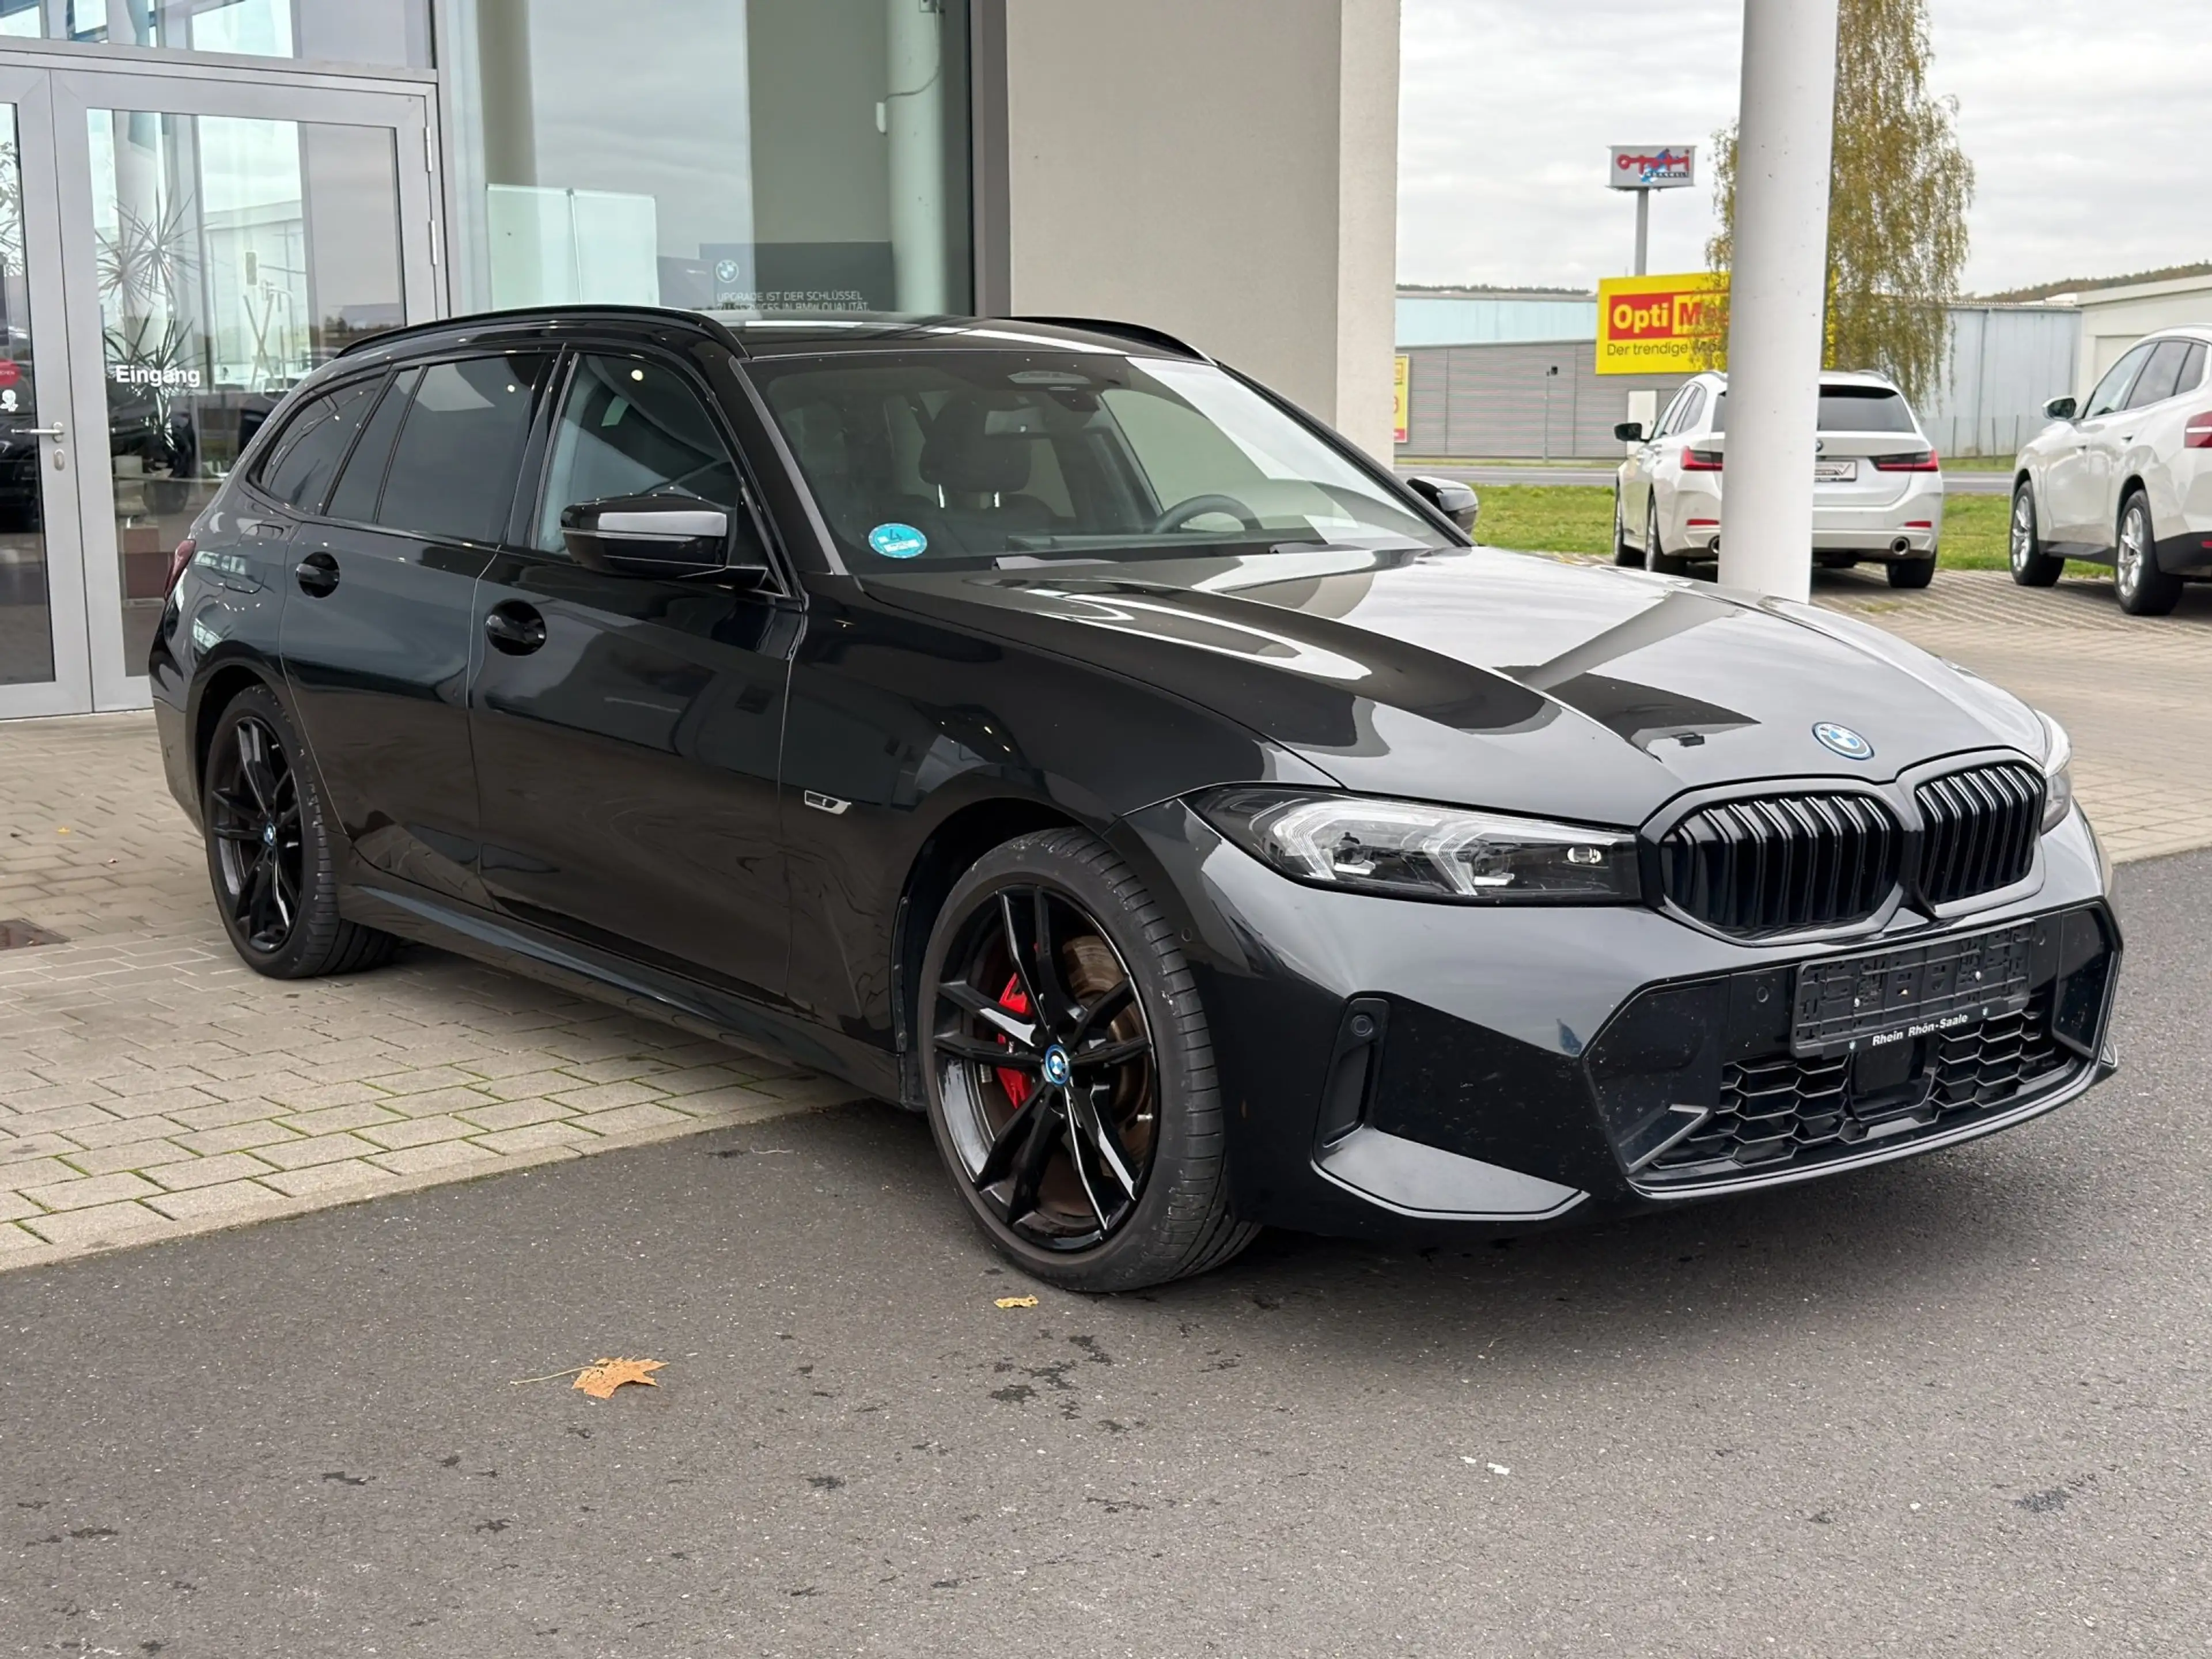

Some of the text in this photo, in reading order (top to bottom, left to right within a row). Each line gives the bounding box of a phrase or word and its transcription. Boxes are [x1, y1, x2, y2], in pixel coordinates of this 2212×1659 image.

[717, 290, 863, 302] UPGRADE IST DER SCHLÜSSEL
[1613, 302, 1669, 334] Opti
[1607, 343, 1629, 356] Der
[1633, 342, 1688, 357] trendige
[116, 365, 200, 387] Eingang
[1873, 1031, 1903, 1046] Rhein
